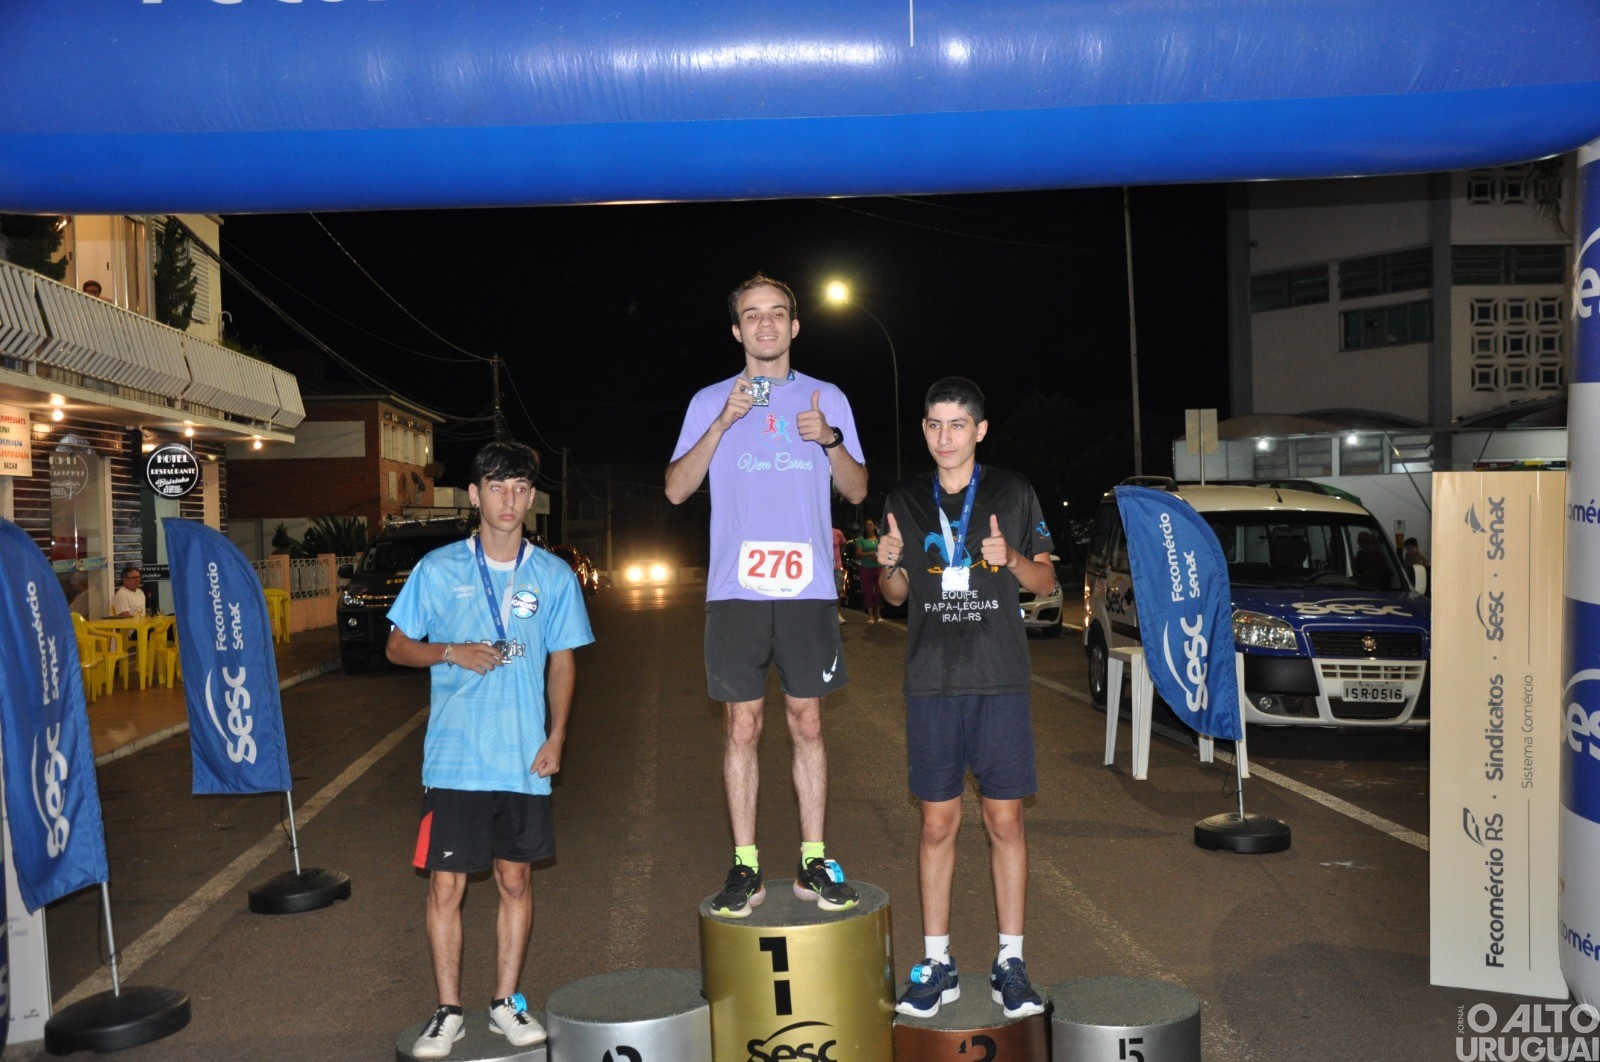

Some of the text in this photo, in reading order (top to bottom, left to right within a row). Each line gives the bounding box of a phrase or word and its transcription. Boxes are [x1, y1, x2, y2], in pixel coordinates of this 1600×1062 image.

[157, 454, 189, 463] HOTEL
[737, 452, 771, 472] Vem
[1158, 512, 1185, 602] Fecomércio
[1486, 496, 1506, 560] Senac
[747, 549, 803, 580] 276
[941, 590, 979, 600] EQUIPE
[206, 561, 228, 652] Fecomércio
[924, 598, 999, 612] PAPA-LÉGUAS
[1485, 673, 1505, 781] Sindicatos
[1521, 674, 1534, 789] Sistema Comércio
[1484, 812, 1504, 841] RS
[1484, 848, 1504, 968] Fecomércio
[759, 936, 793, 1016] 1
